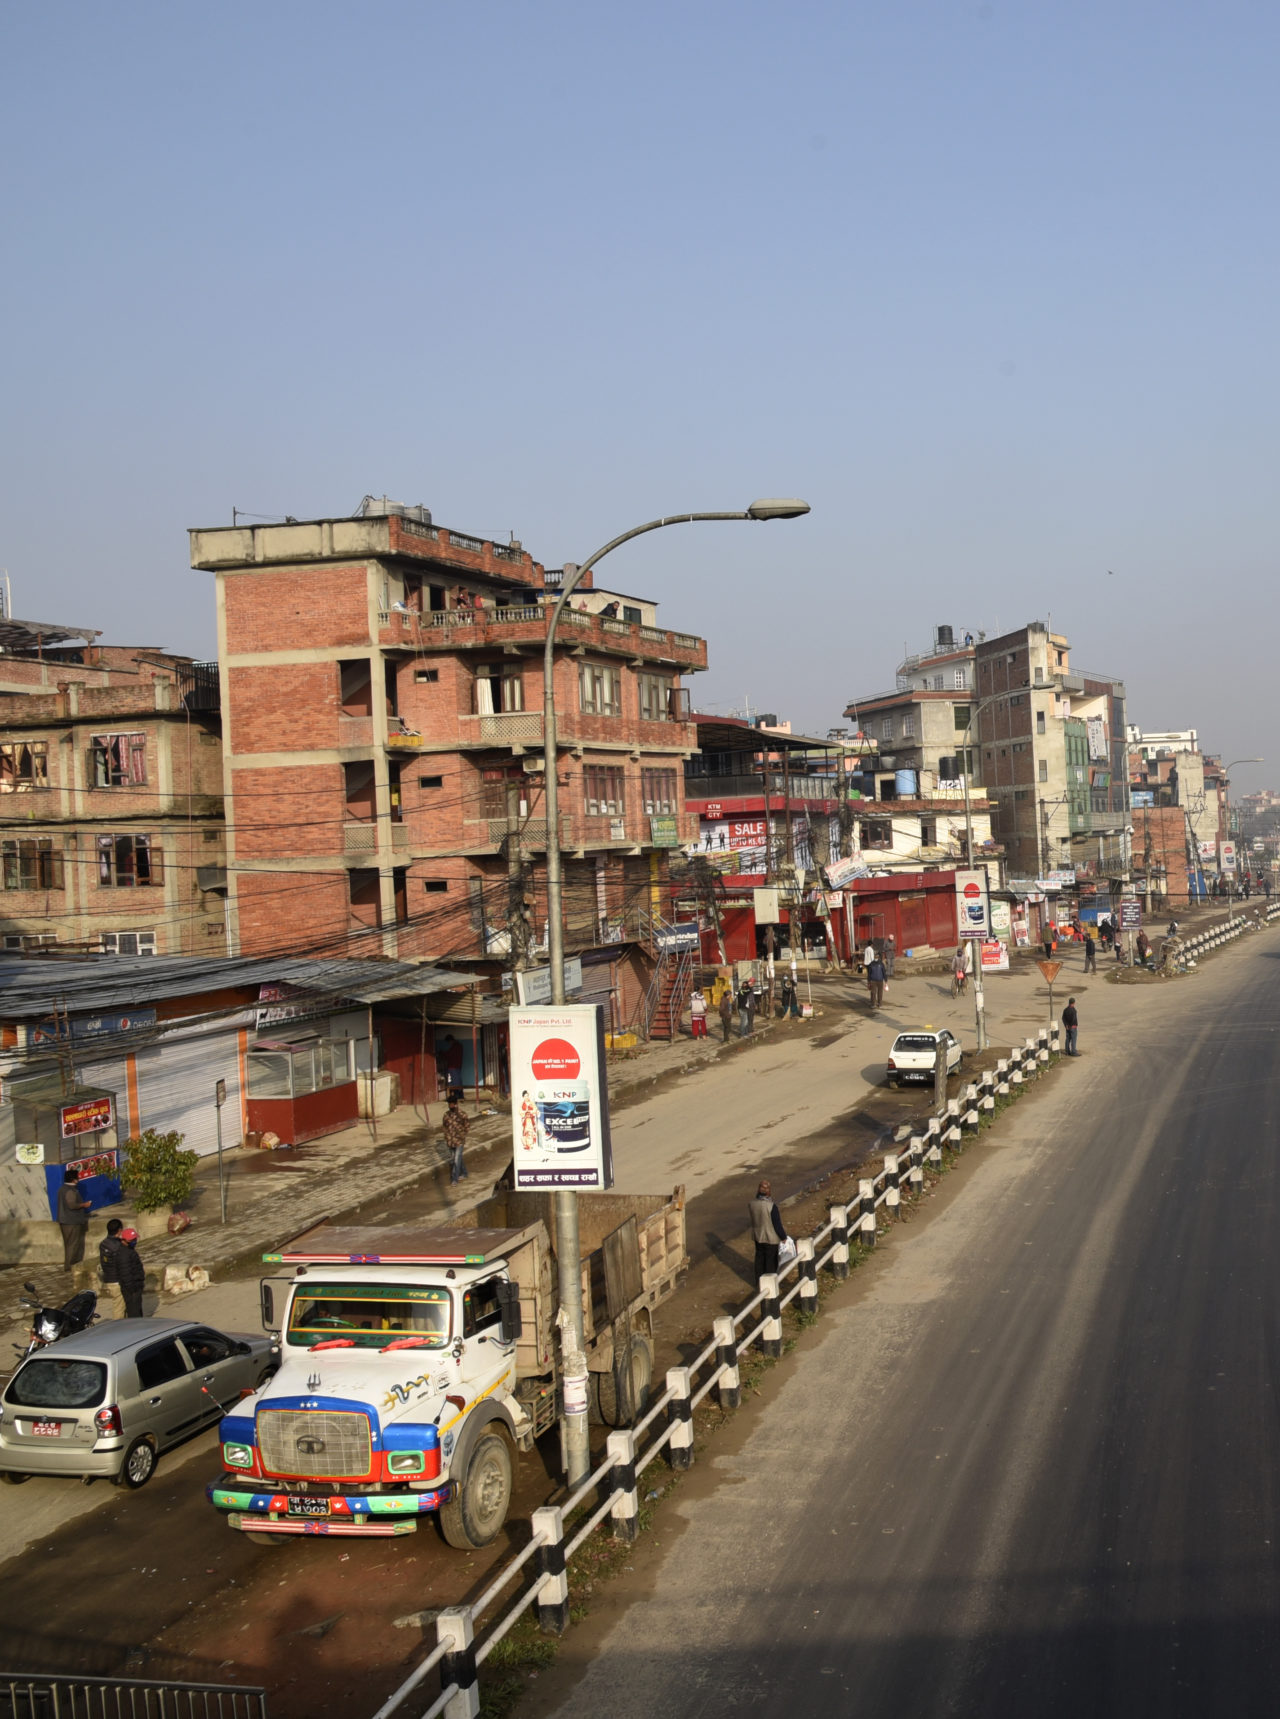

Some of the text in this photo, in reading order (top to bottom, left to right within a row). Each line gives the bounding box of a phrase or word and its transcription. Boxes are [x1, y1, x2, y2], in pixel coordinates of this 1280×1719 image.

[735, 822, 764, 835] SALE
[553, 1091, 577, 1099] KNP
[545, 1117, 579, 1125] EXCEL
